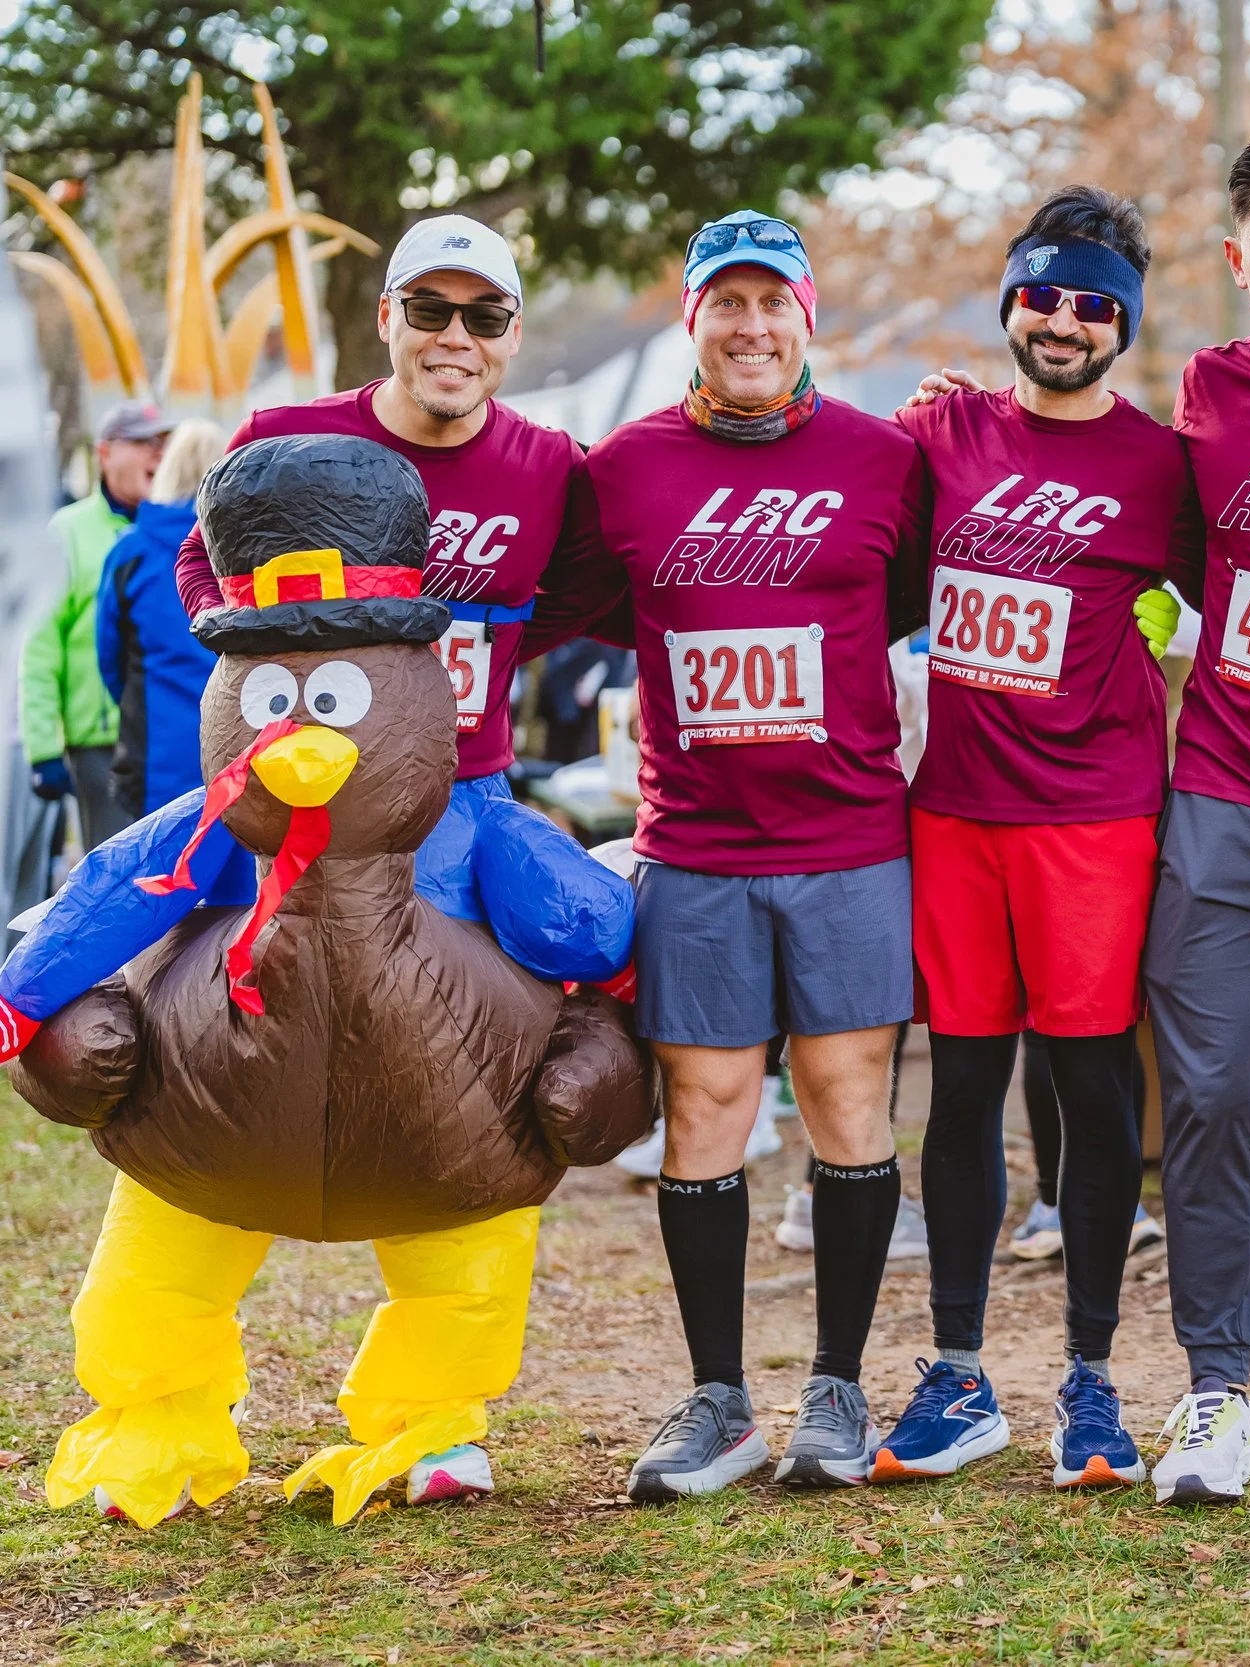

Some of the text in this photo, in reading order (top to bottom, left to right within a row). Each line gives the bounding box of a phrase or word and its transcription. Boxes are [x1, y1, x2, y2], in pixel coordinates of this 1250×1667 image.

[684, 487, 845, 536] LRC
[971, 474, 1122, 536] LRC
[429, 509, 520, 566] RC
[653, 535, 822, 587] RUN
[937, 513, 1091, 579] RUN
[937, 583, 1053, 664] 2863
[683, 643, 806, 713] 3201
[931, 660, 1051, 692] TRISTATE TIMING
[758, 723, 816, 737] TIMING
[817, 1163, 891, 1180] ZENSAH
